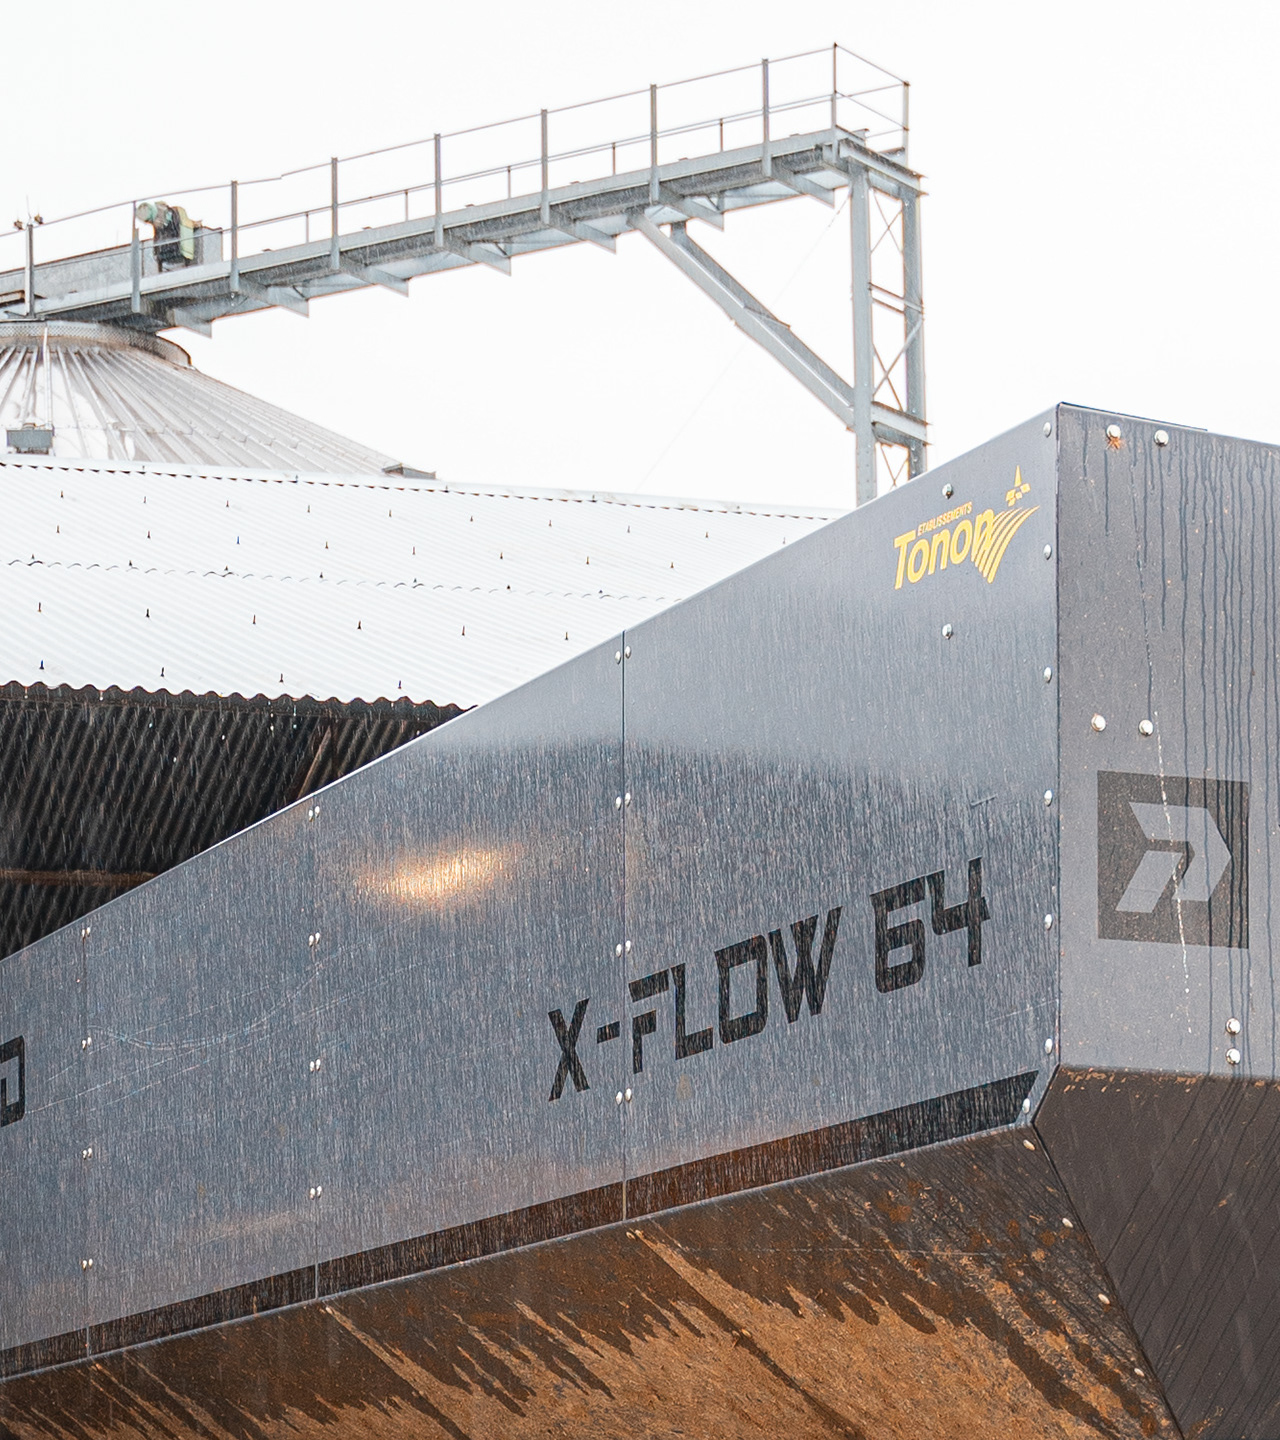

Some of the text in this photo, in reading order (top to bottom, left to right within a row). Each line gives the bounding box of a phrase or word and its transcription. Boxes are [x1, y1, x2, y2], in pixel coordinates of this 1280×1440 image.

[893, 509, 997, 590] Tonon
[547, 857, 990, 1102] X-FLOW 64
